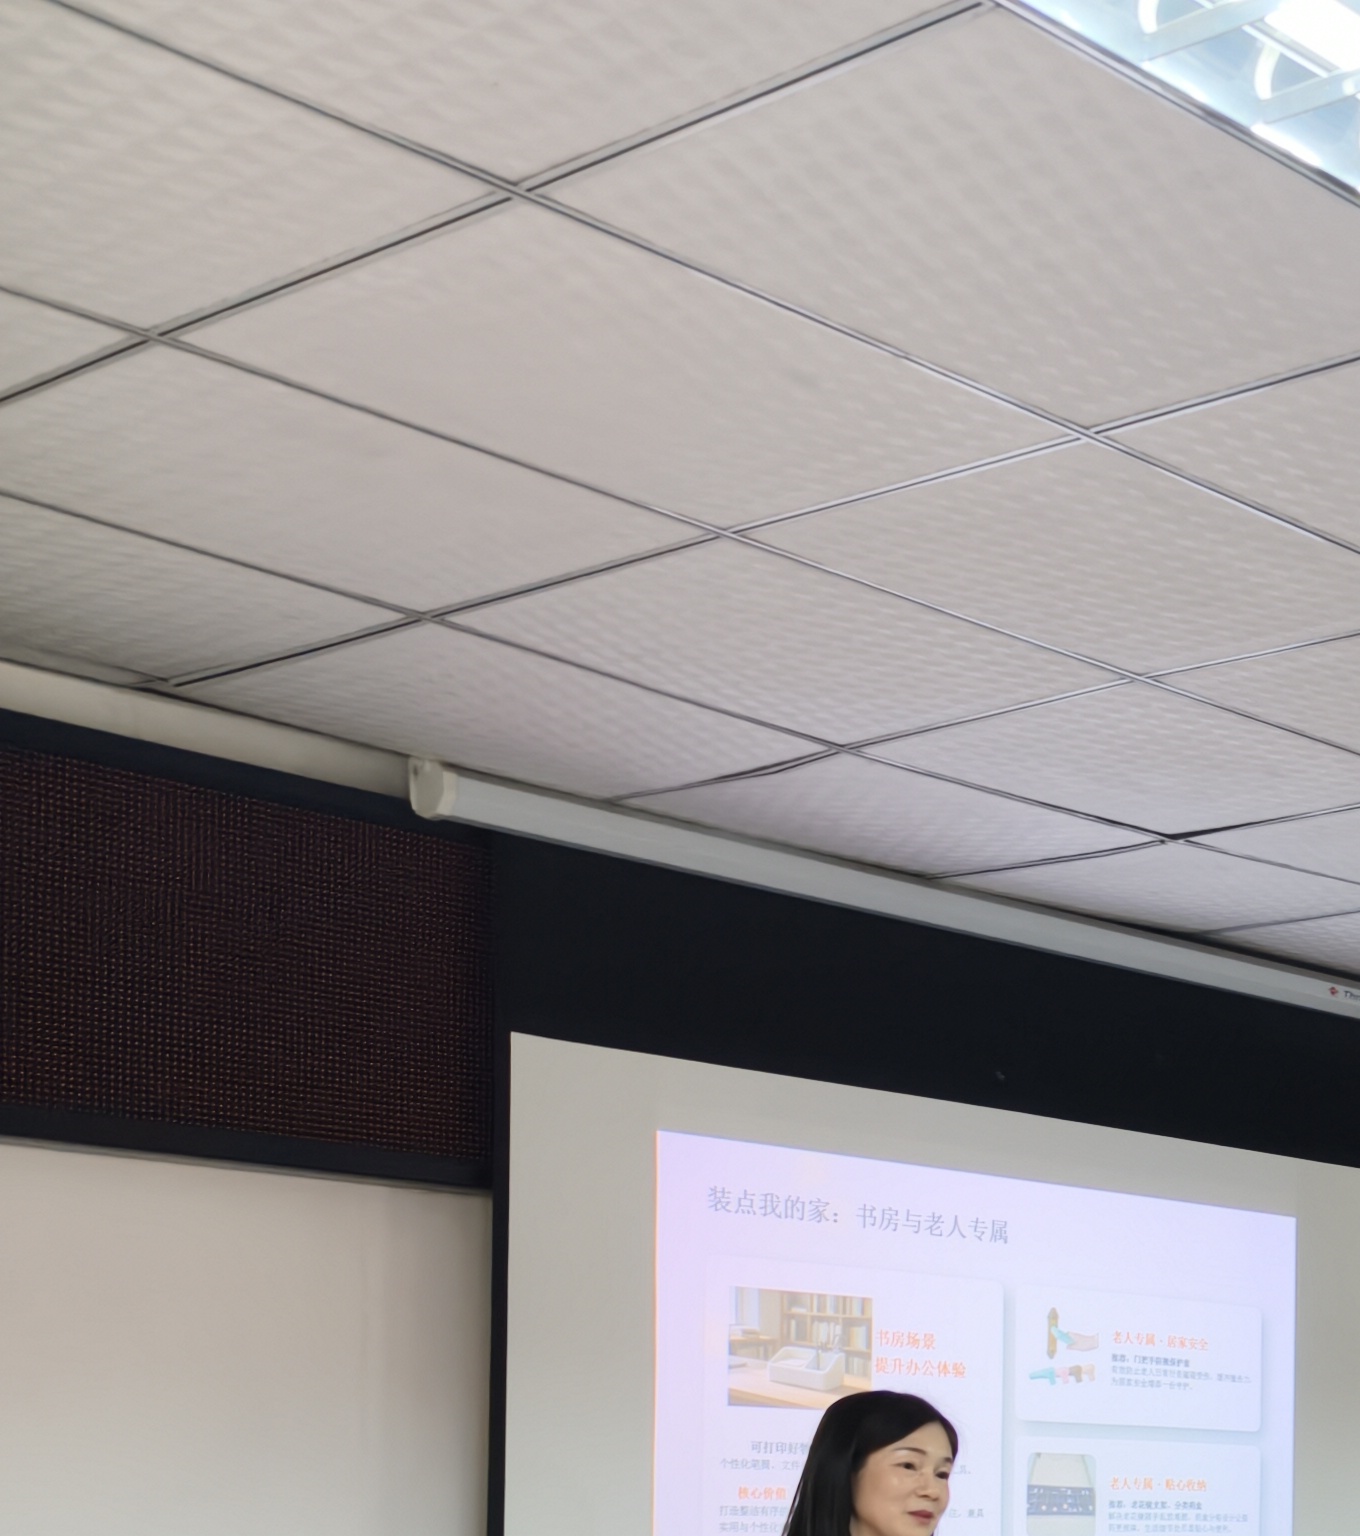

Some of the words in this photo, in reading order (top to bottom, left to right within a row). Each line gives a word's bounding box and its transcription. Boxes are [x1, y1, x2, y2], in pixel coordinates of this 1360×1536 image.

[707, 1185, 1009, 1245] 装点我的家：书房与老人专属
[876, 1328, 937, 1350] 书房场景
[874, 1356, 967, 1379] 提升办公体验
